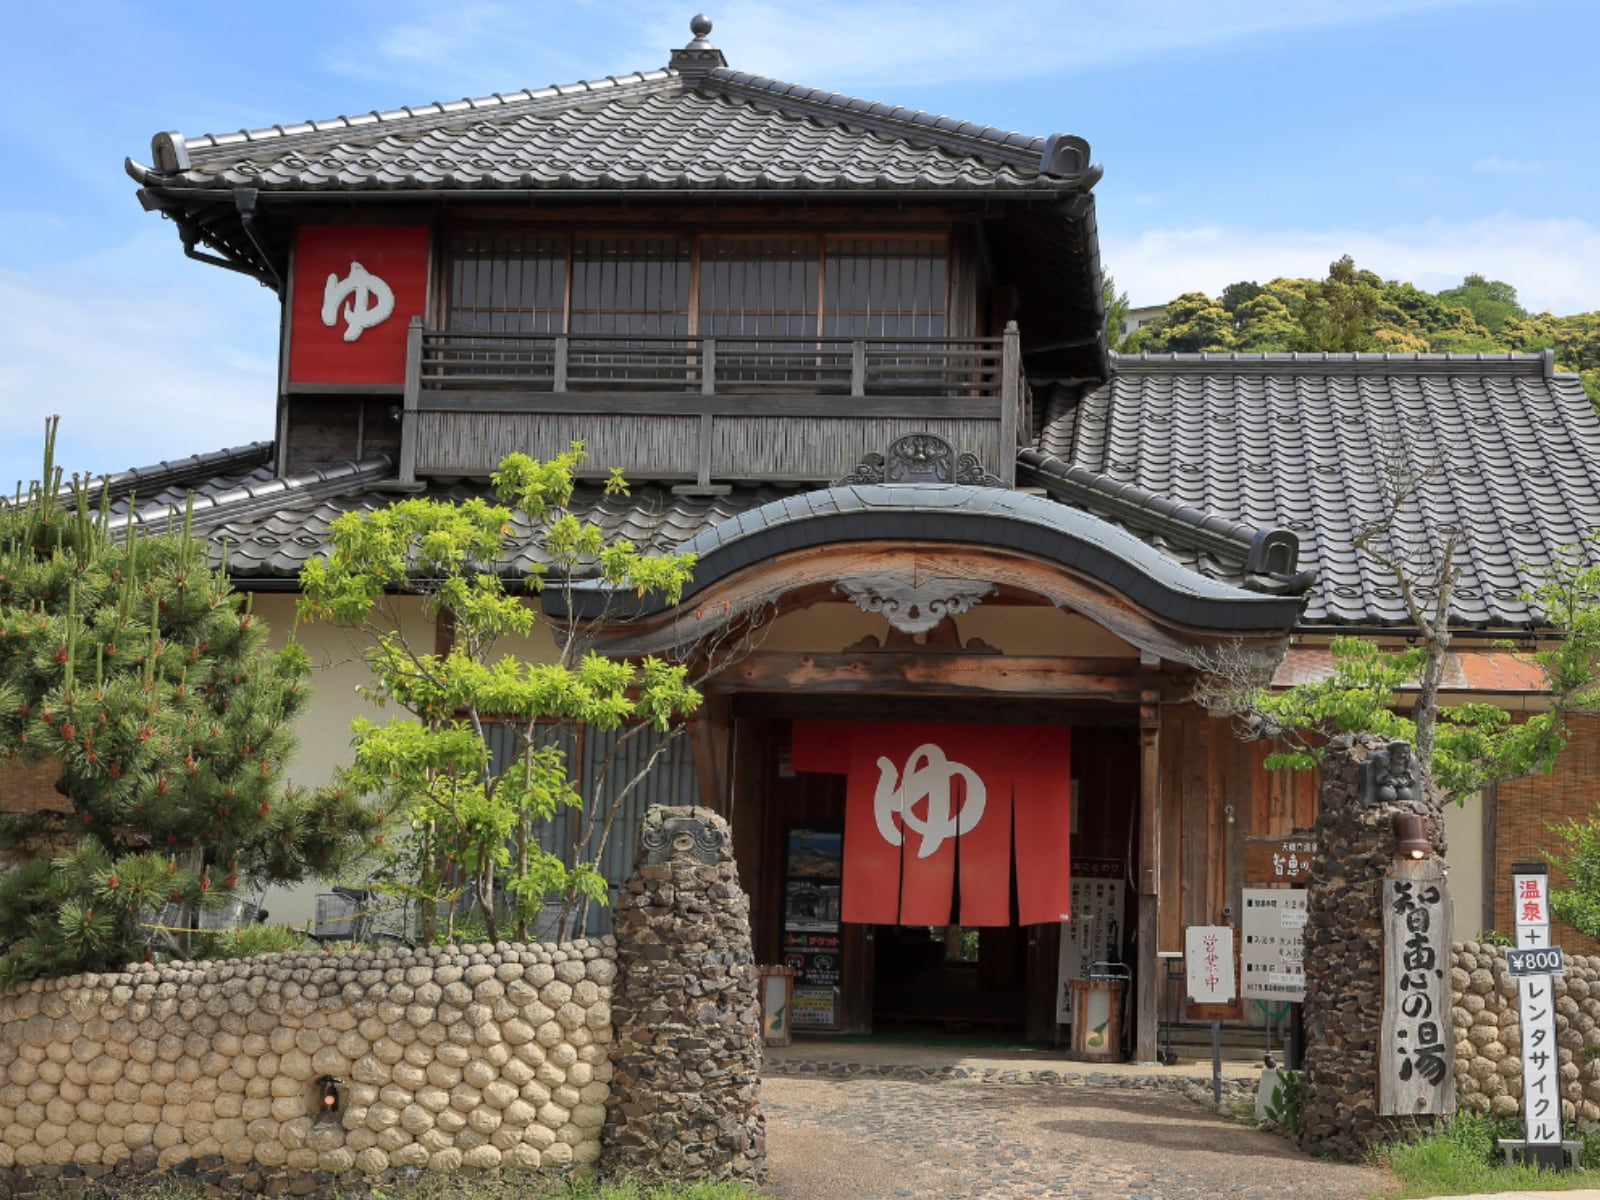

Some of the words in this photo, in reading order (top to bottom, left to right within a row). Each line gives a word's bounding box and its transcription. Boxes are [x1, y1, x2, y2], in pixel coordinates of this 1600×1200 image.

[321, 261, 395, 342] ゆ
[874, 743, 986, 859] ゆ
[1273, 852, 1315, 876] 智恵の
[1519, 880, 1542, 921] 温泉
[1203, 934, 1219, 992] 営業中
[1393, 880, 1446, 1087] 智恵の湯
[1512, 952, 1559, 970] ¥800
[1529, 982, 1555, 1141] レンタサイクル
